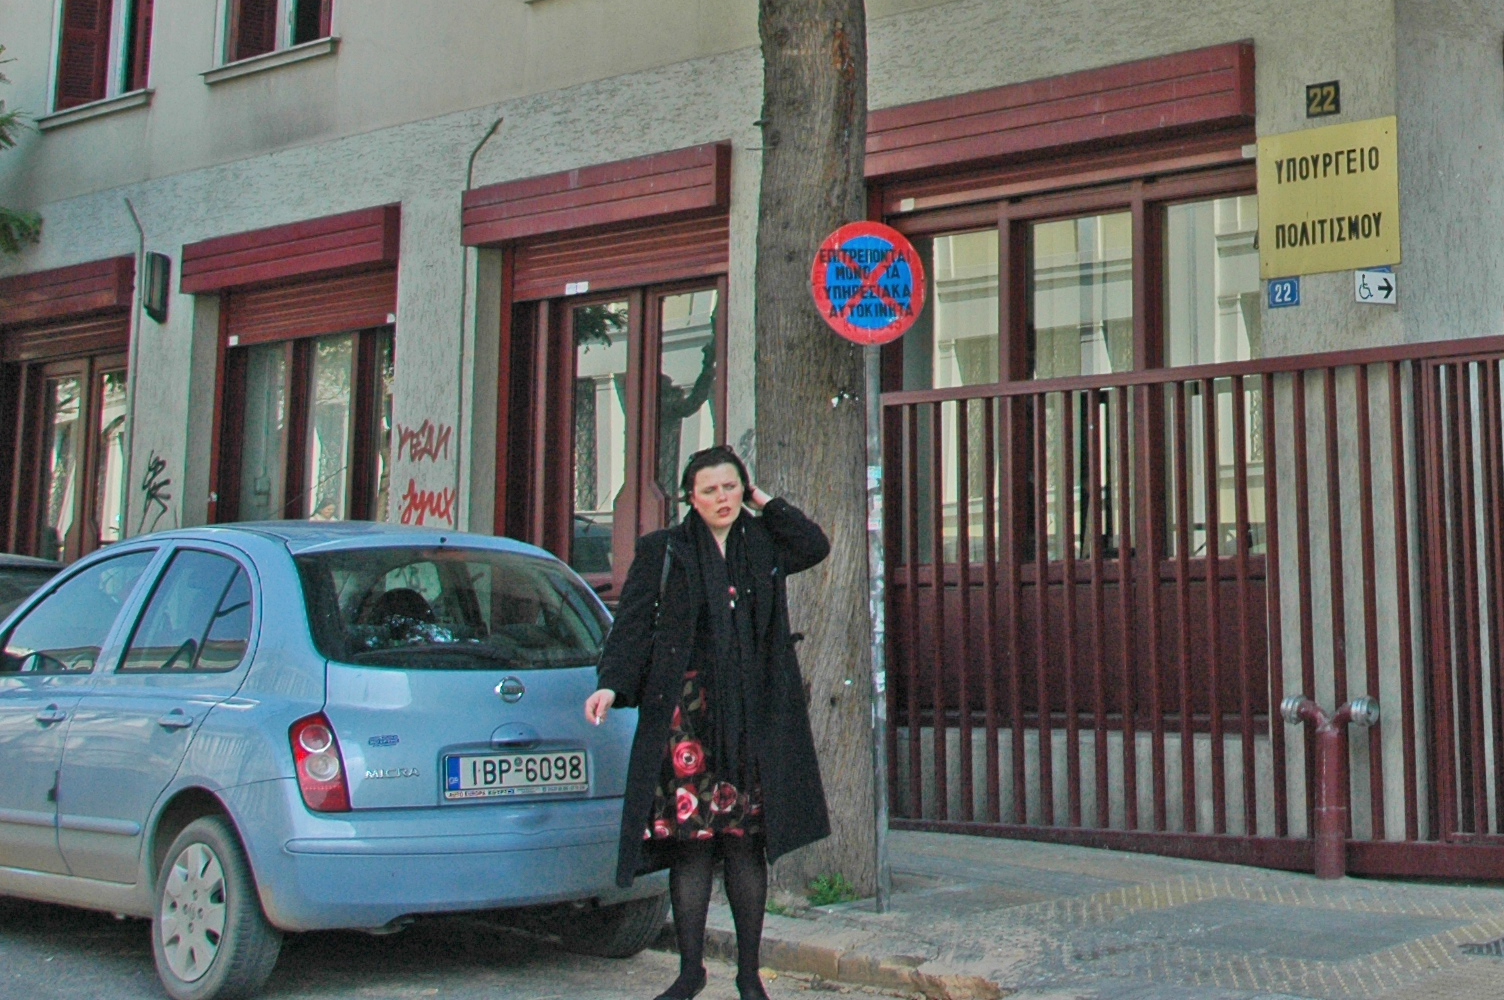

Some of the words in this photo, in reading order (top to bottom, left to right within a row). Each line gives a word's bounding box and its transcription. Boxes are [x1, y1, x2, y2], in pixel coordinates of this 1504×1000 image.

[1308, 85, 1337, 115] 22
[1274, 145, 1380, 185] ΥΠΟΥΡΓΕΙΟ
[1275, 211, 1383, 250] ΠΟΛΙΤΙΣΜΟΥ
[819, 248, 911, 264] ΕΠΙΤΡΕΠΟΝΤΑΙ
[835, 265, 871, 281] ΜΟΝΟ
[885, 264, 901, 280] ΤΑ
[824, 284, 912, 300] ΥΠΗΡΕΣΙΑΚΑ
[1274, 282, 1292, 304] 22
[829, 302, 914, 319] ΑΥΤΟΚΙΝΗΤΑ
[365, 767, 420, 780] MICRA
